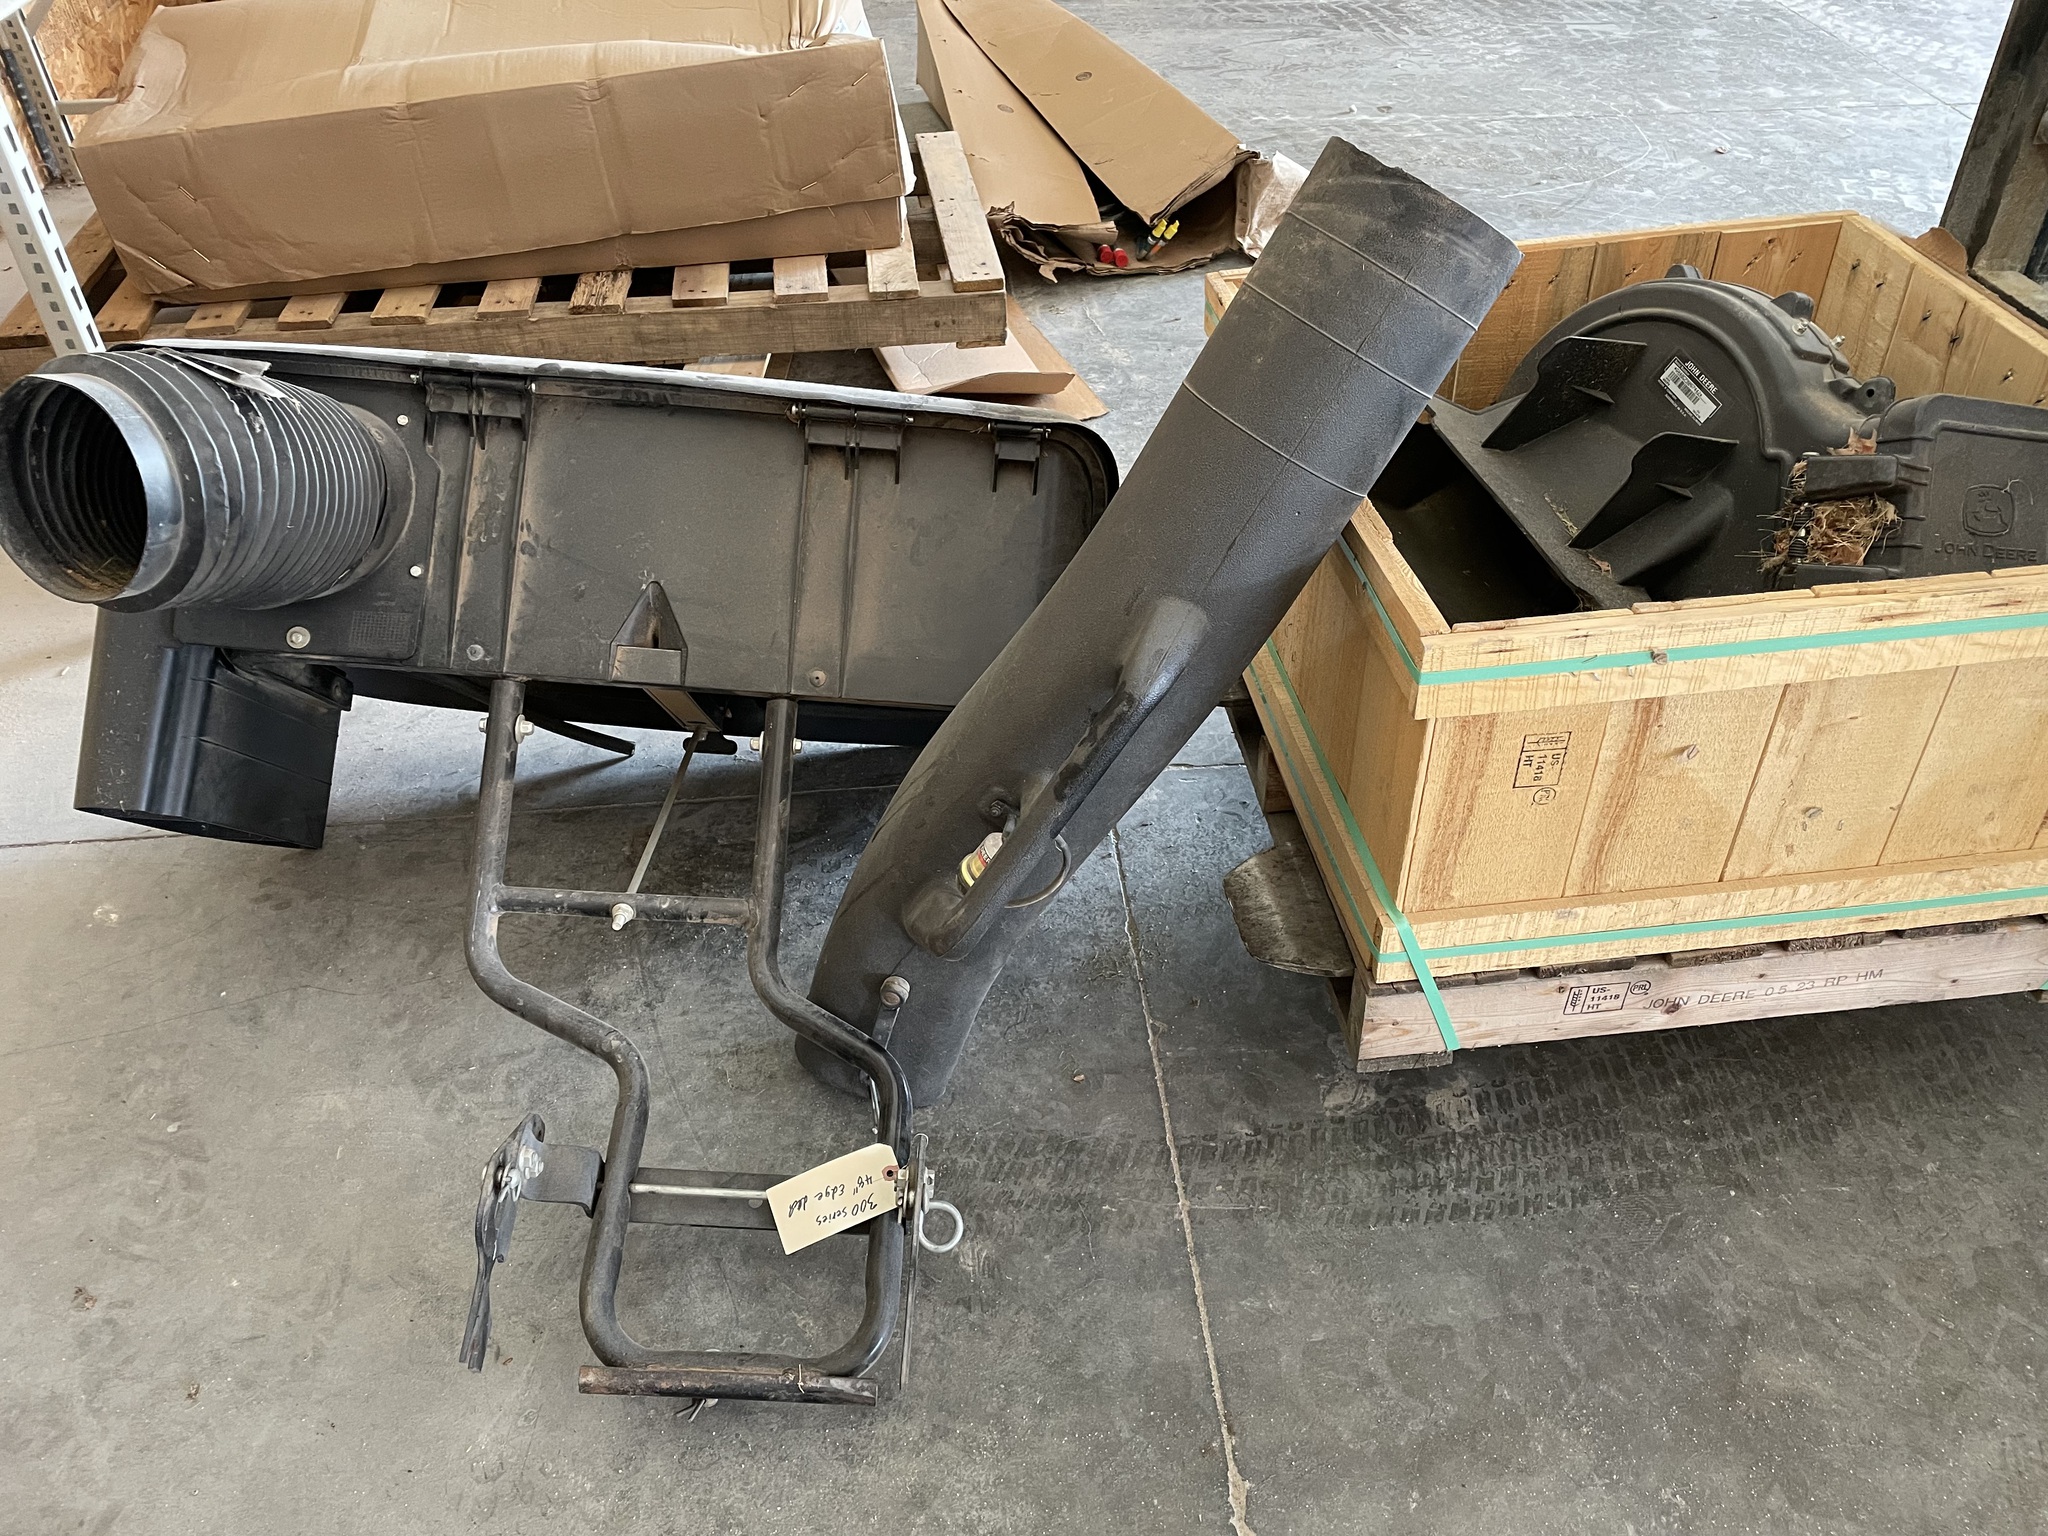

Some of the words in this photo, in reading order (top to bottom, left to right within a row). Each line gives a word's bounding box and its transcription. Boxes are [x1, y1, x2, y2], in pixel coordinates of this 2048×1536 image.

[1684, 360, 1701, 377] JOHN
[1698, 374, 1719, 395] DEERE
[1934, 539, 1977, 557] JOHN
[1982, 542, 2038, 562] DEERE
[1523, 754, 1535, 768] HT
[1533, 754, 1548, 782] 11418
[1590, 994, 1620, 1002] 11418
[1642, 995, 1691, 1010] JOHN
[1697, 988, 1758, 1005] DEERE
[1823, 975, 1848, 988] RP
[1855, 968, 1884, 982] HM
[1586, 1003, 1602, 1011] HT
[814, 1183, 845, 1201] Edge
[851, 1192, 878, 1217] 300
